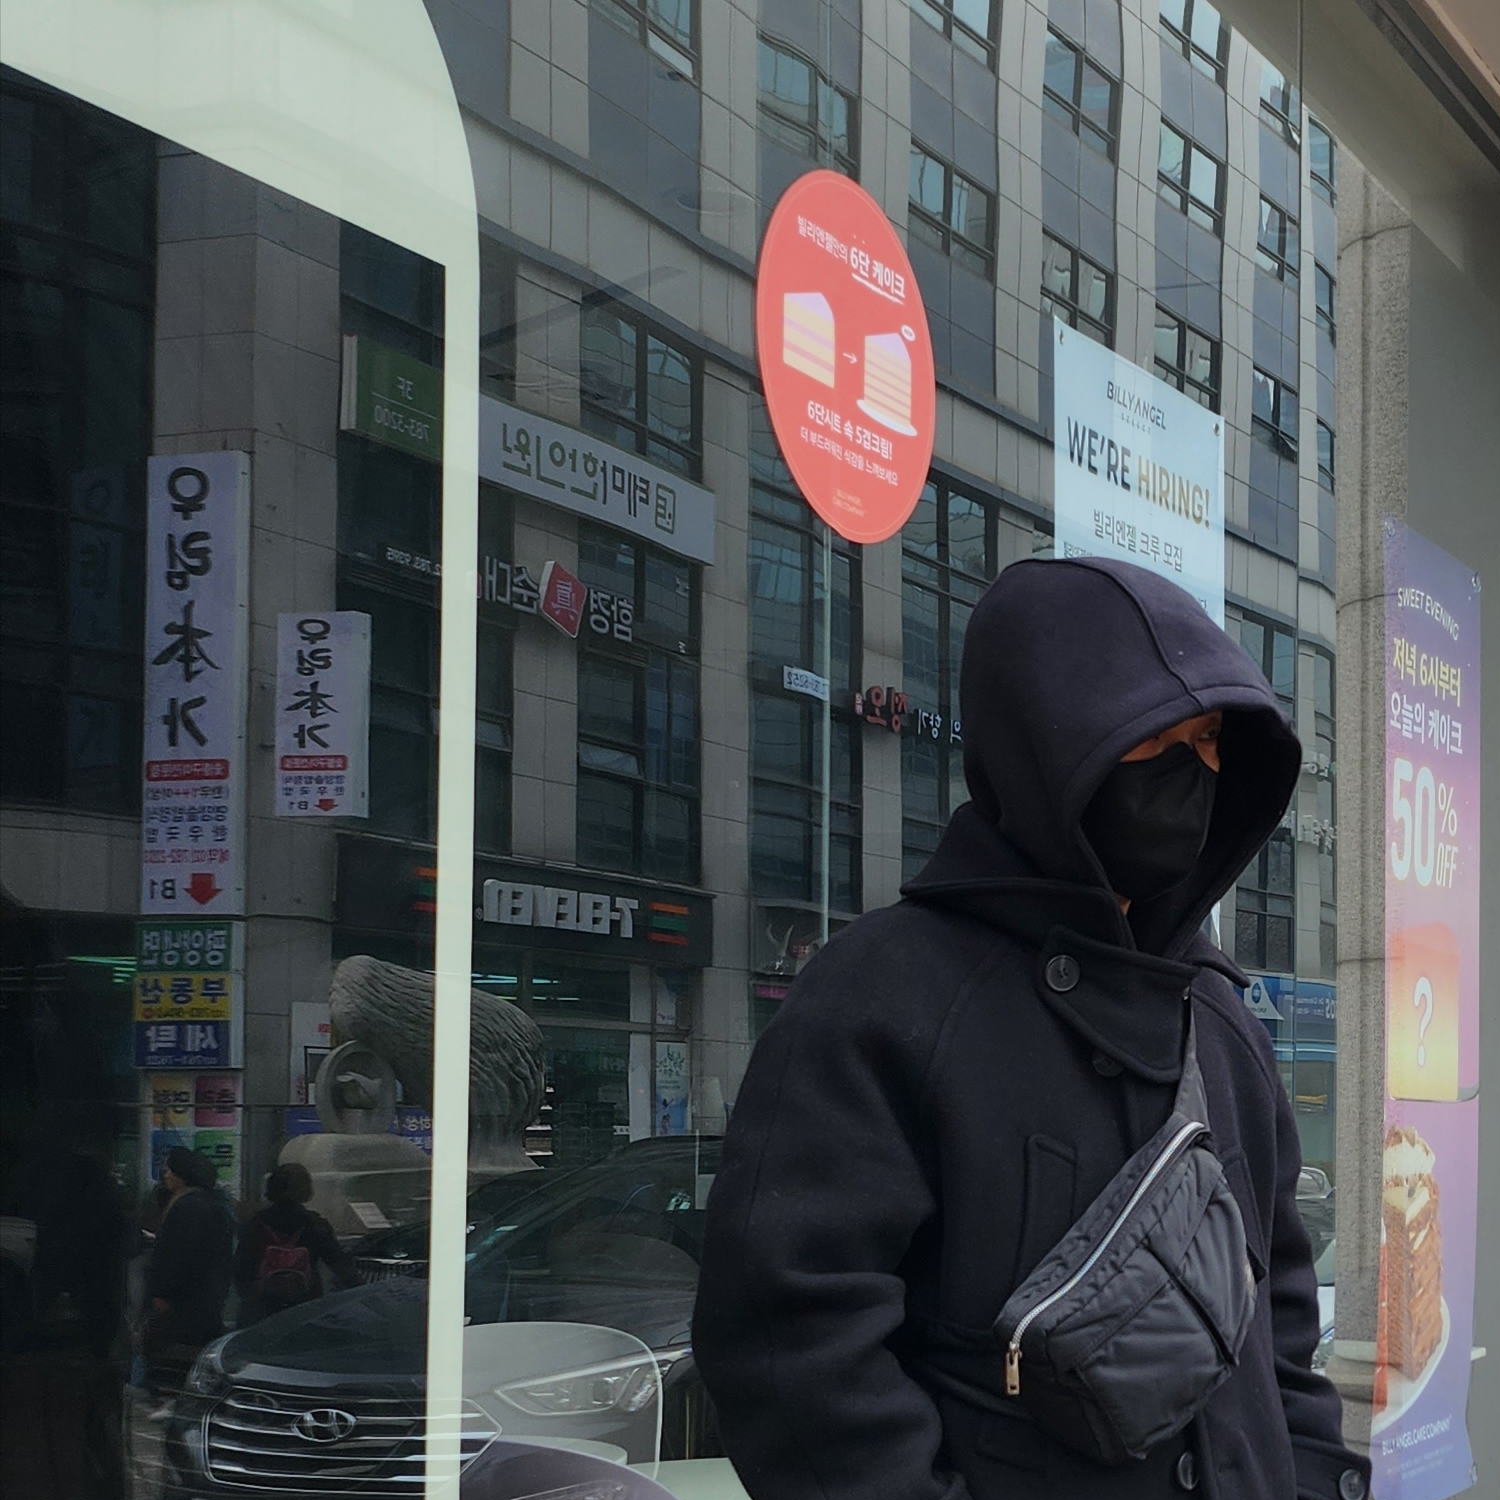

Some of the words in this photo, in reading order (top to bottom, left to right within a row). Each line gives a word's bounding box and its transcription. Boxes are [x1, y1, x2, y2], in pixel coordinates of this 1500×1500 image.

[850, 247, 870, 278] 6단
[872, 260, 905, 298] 케이크
[801, 426, 808, 443] 더
[807, 400, 842, 435] 6단시트
[844, 420, 853, 441] 속
[1137, 454, 1210, 530] HIRING!
[1093, 508, 1137, 554] 빌리엔젤
[1139, 531, 1161, 563] 크루
[1163, 540, 1183, 573] 모집
[1397, 587, 1425, 613] SWEET
[1425, 596, 1460, 642] EVENING
[1393, 636, 1418, 688] 저녁
[1419, 652, 1461, 709] 6시부터
[1389, 695, 1427, 745] 오늘의
[1427, 706, 1463, 757] 케이크
[1434, 844, 1459, 889] OFF
